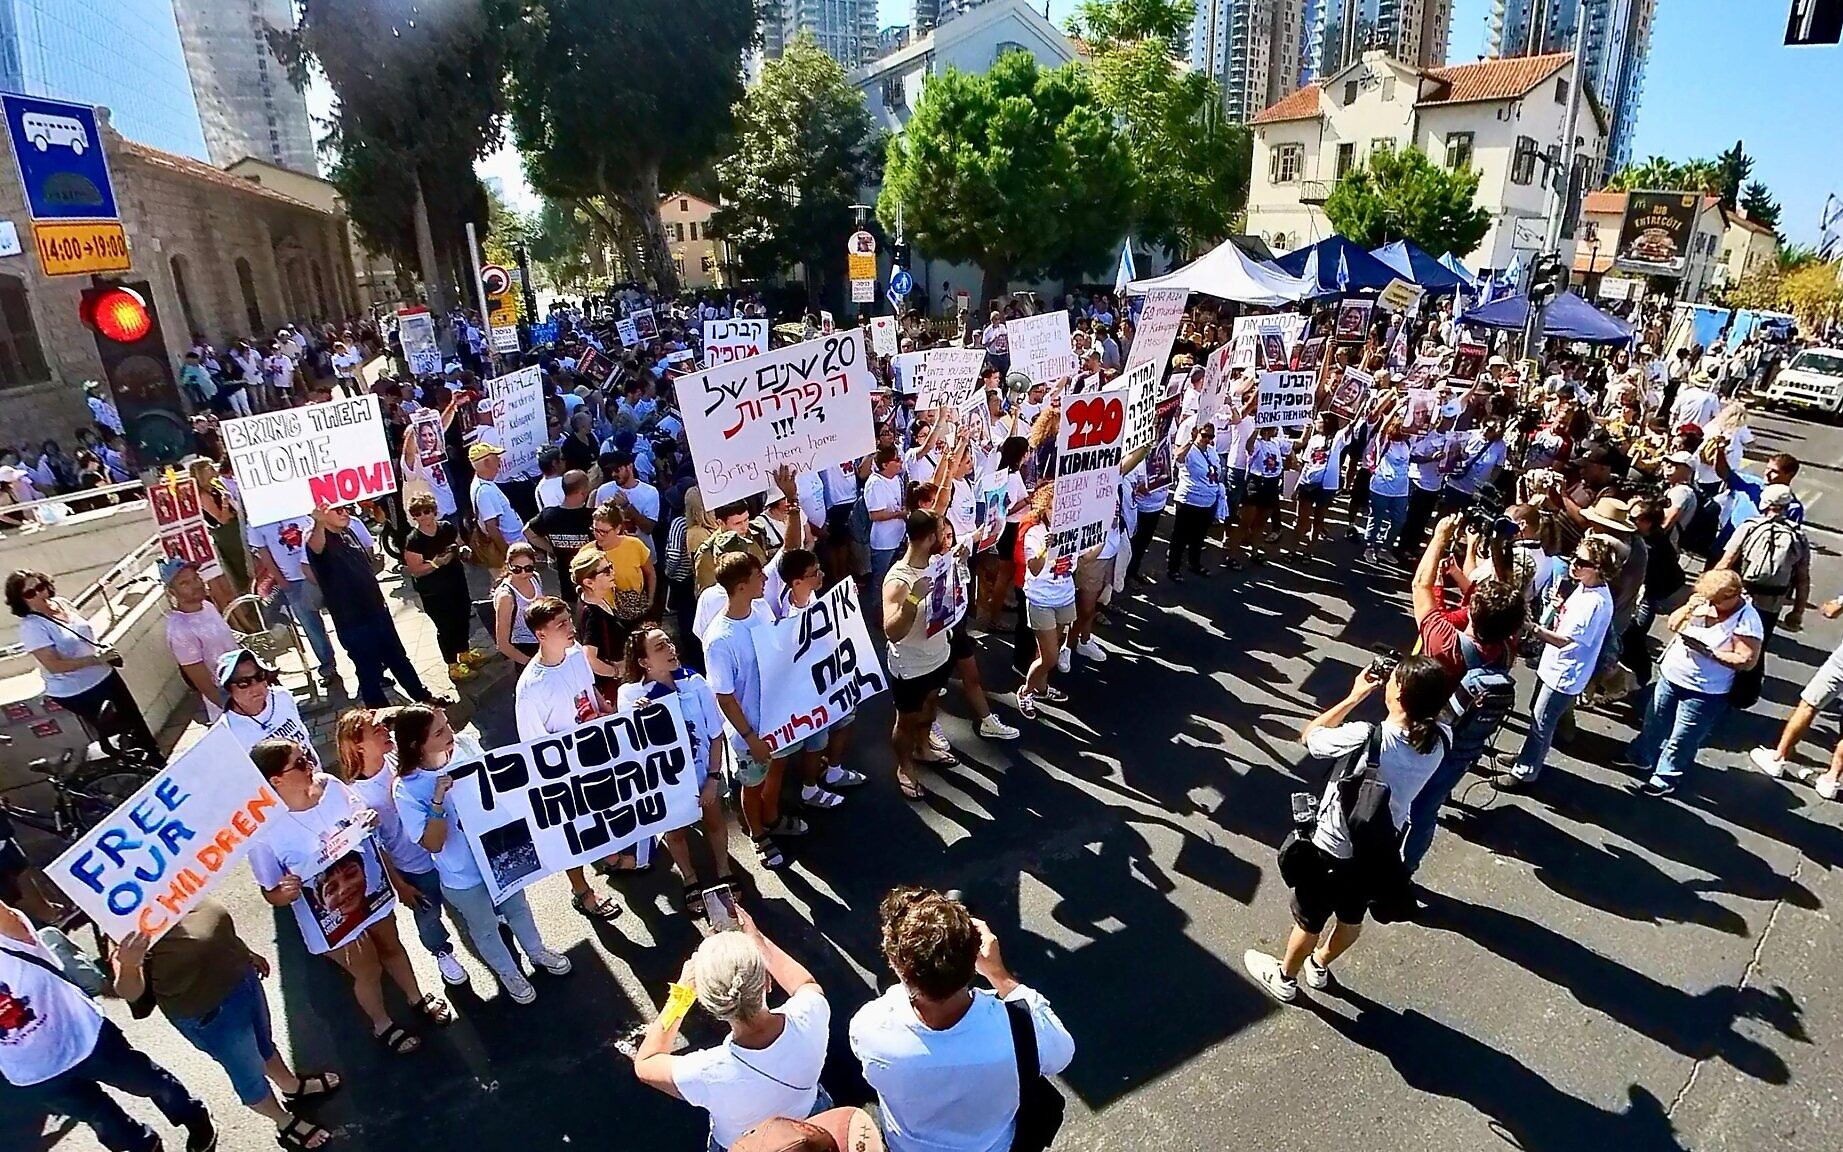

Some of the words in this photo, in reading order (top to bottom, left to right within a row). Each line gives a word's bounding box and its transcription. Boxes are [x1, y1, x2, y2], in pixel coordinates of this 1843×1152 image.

[1653, 205, 1668, 215] RIB
[42, 238, 82, 261] 14:00
[93, 235, 125, 257] 19:00
[713, 323, 761, 341] קברנו
[756, 354, 818, 393] שנים
[823, 336, 855, 376] 20
[702, 375, 748, 417] של
[1279, 374, 1313, 390] קברנו
[224, 412, 301, 450] BRING
[307, 398, 373, 432] THEM
[492, 400, 505, 419] 62
[1066, 396, 1124, 450] 220
[234, 436, 338, 490] HOME
[704, 458, 760, 495] Bring
[764, 444, 802, 463] them
[807, 433, 838, 450] home
[1058, 446, 1122, 478] KIDNAPPED
[308, 461, 395, 508] NOW!
[1051, 528, 1079, 549] BRING
[1081, 520, 1103, 542] THEM
[1058, 541, 1077, 558] ALL
[811, 637, 857, 696] כוח
[69, 777, 192, 894] FREE
[107, 819, 196, 916] OUR
[138, 786, 277, 937] CHILDREN
